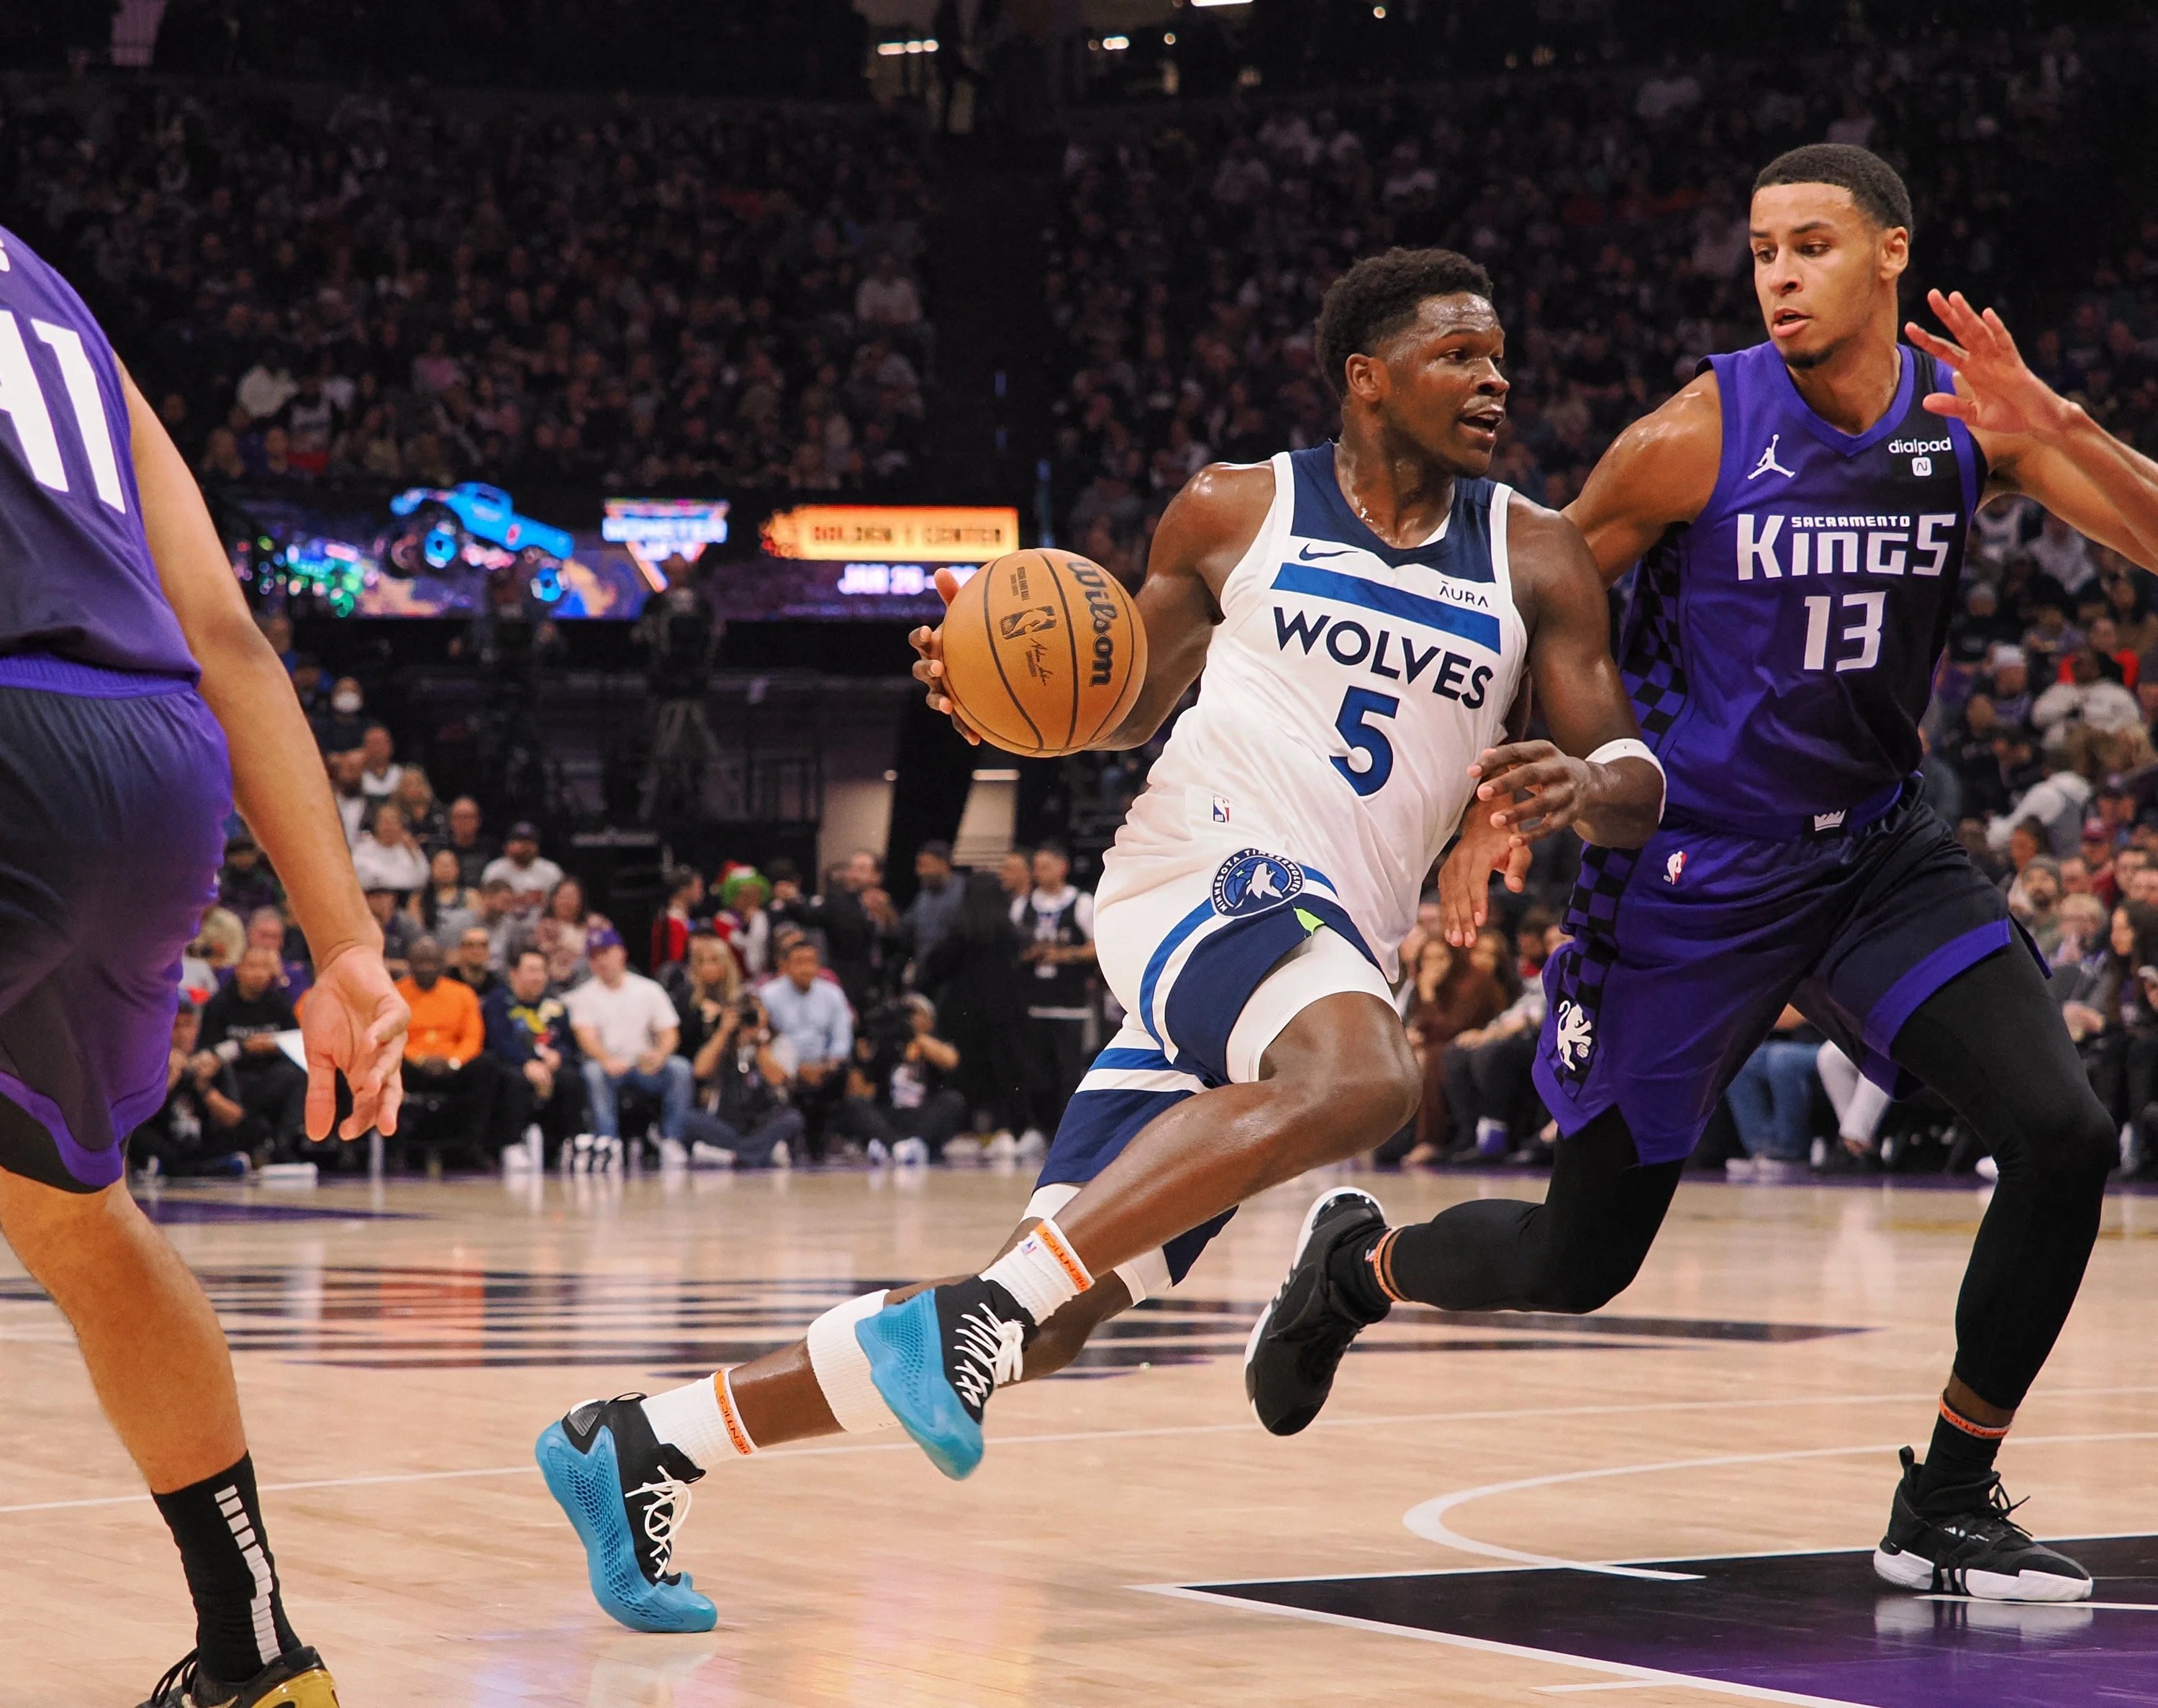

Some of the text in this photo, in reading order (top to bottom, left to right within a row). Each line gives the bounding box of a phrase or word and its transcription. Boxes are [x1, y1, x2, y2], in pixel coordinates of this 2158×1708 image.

[1888, 437, 1952, 456] dialpad
[1792, 516, 1910, 527] SACRAMENTO
[1066, 561, 1118, 687] Wilson
[1273, 607, 1494, 709] WOLVES
[1804, 591, 1887, 672] 13
[1328, 685, 1400, 796] 5
[1212, 856, 1241, 912] MINNESOTA
